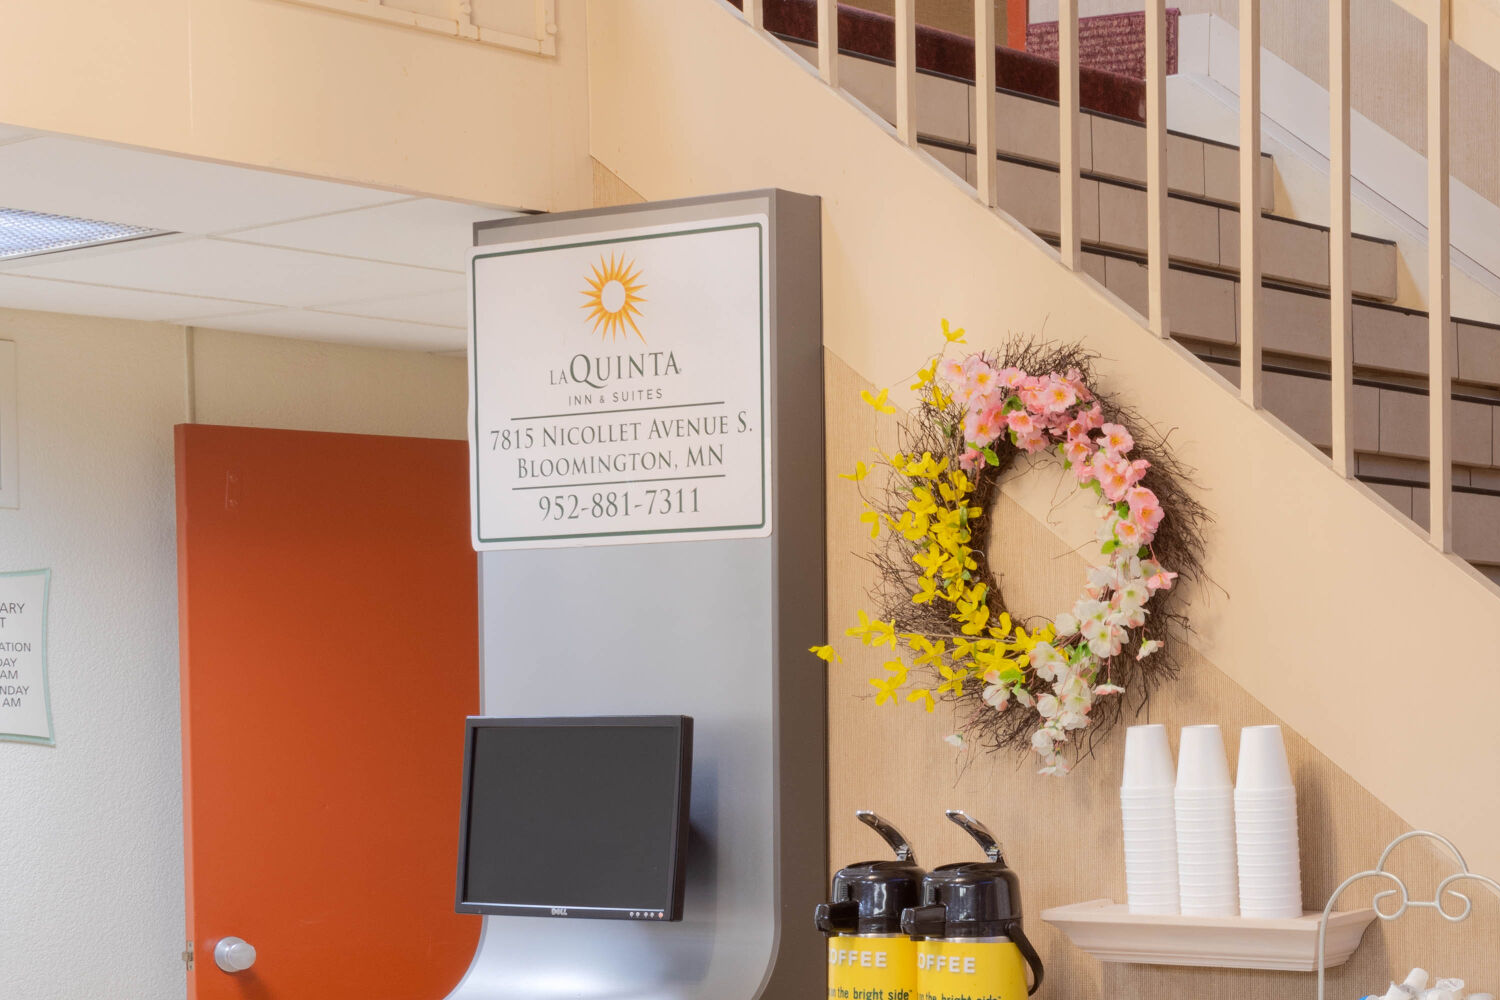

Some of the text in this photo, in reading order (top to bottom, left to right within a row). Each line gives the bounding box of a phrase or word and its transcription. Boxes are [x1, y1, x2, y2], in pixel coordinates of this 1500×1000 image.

[550, 351, 680, 388] LA QUINTA
[568, 388, 663, 406] INN & SUITES
[490, 410, 752, 451] 7815 NICOLLET AVENUE S.
[517, 443, 723, 478] BLOOMINGTON, MN
[539, 487, 700, 521] 952-881-7311
[0, 670, 18, 680] AM
[3, 698, 21, 707] AM
[829, 948, 887, 967] OFFEE
[917, 953, 976, 973] OFFEE
[838, 986, 849, 998] the
[888, 988, 909, 1000] side
